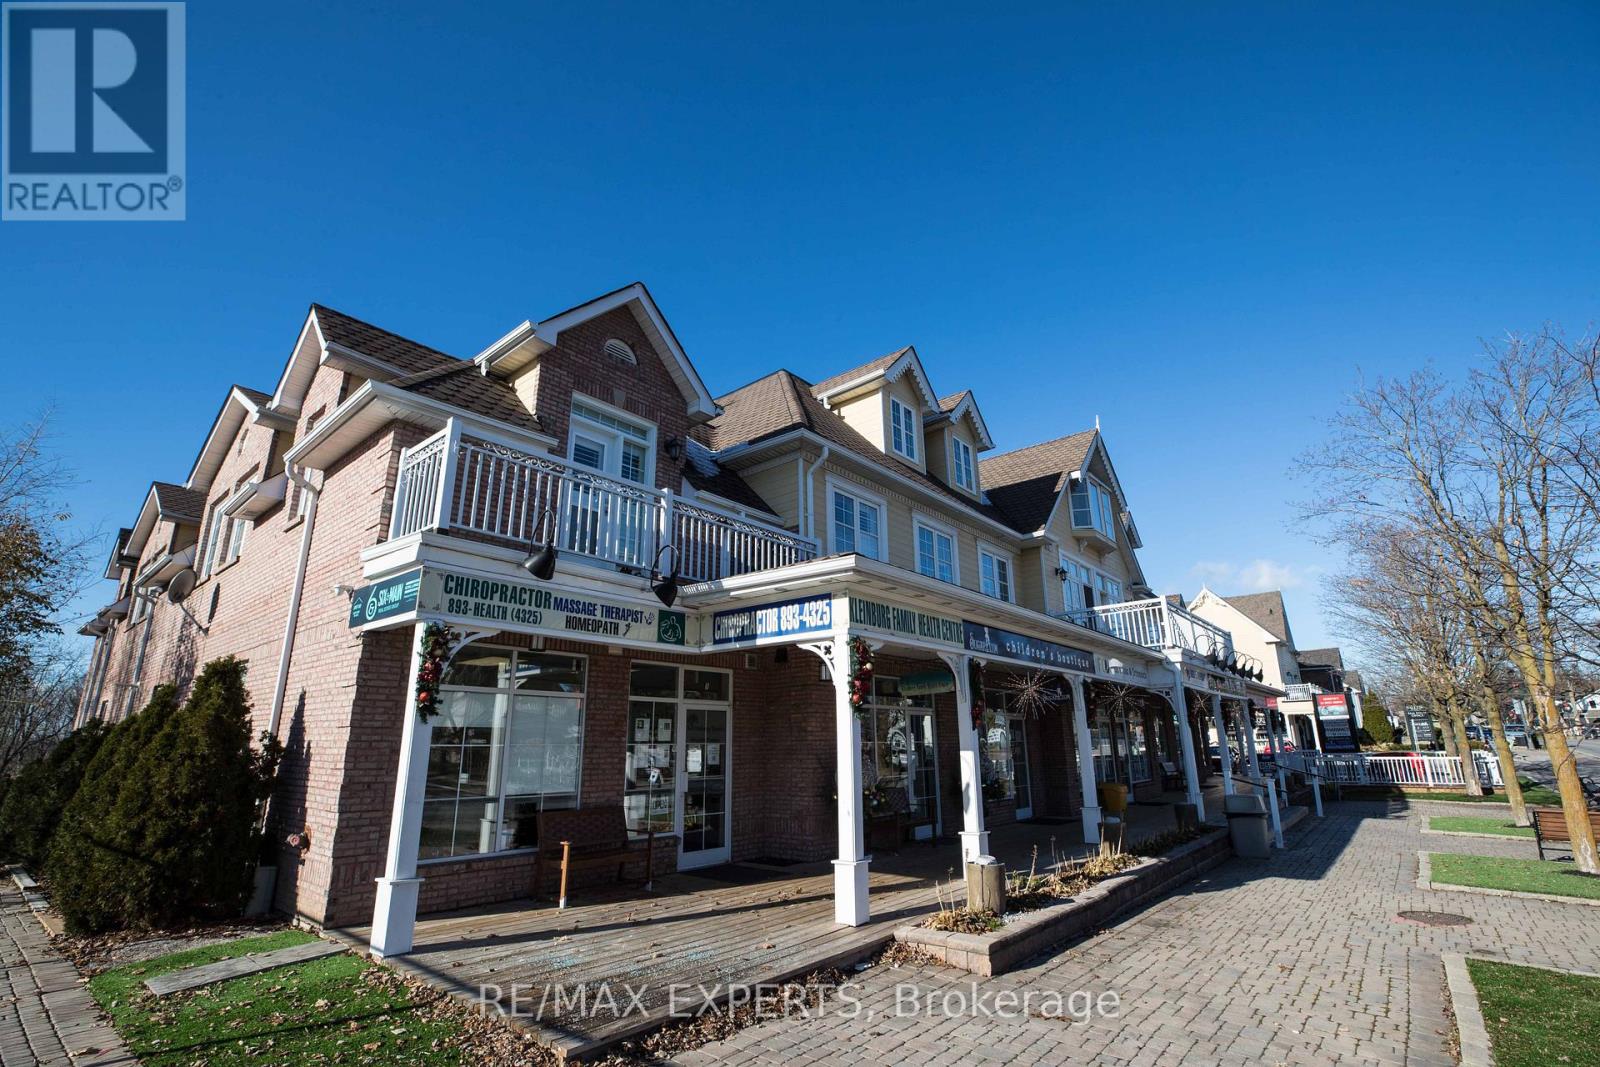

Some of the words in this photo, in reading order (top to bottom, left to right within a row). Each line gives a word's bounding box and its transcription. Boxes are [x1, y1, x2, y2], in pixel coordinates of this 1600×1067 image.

[444, 574, 552, 609] CHIROPRACTOR
[553, 596, 598, 617] MASSAGE
[600, 604, 645, 625] THERAPIST
[511, 607, 543, 625] (4325)
[565, 615, 619, 635] HOMEOPATH
[714, 608, 779, 640] CHIROPRACTOR
[780, 599, 832, 632] 893-4325
[849, 597, 891, 630] KLEINBURG
[892, 607, 916, 635] FAMILY
[918, 613, 941, 641] HEALTH
[941, 619, 964, 645] CENTRE
[1057, 651, 1090, 668] boutique
